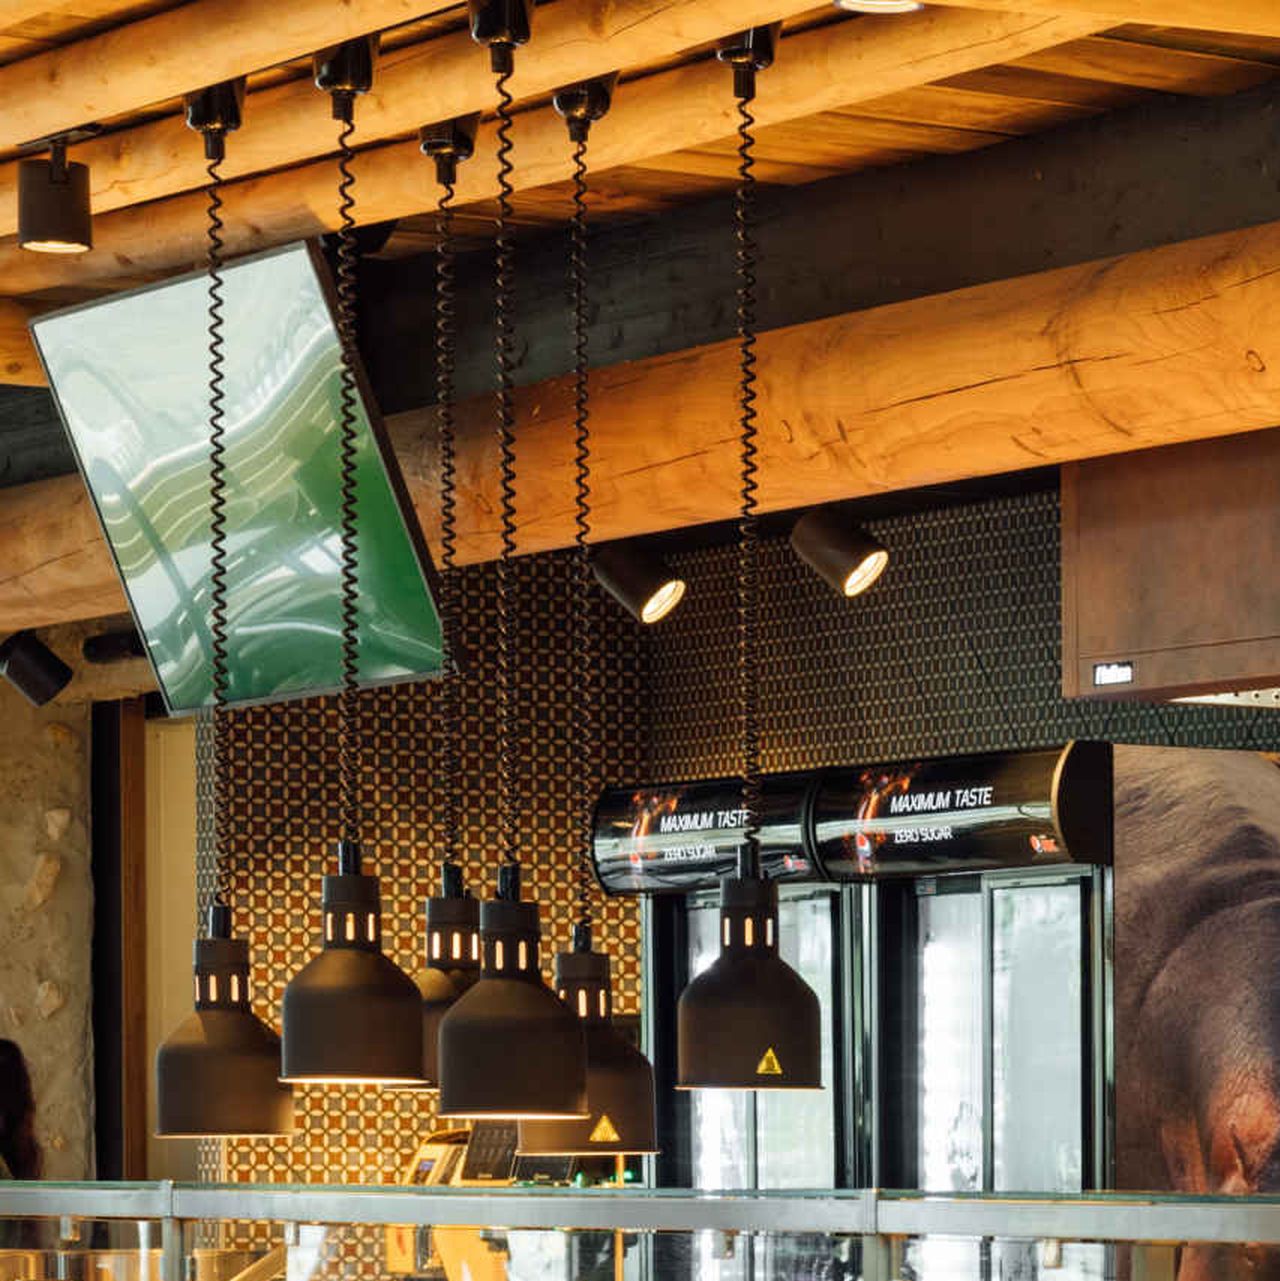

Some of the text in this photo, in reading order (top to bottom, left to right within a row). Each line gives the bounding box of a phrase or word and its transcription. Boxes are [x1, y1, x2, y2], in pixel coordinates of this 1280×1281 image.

[890, 786, 993, 813] MAXIMUM TASTE
[660, 809, 751, 833] MAXIMUM TASTE
[894, 826, 953, 844] ZERO SUGAR
